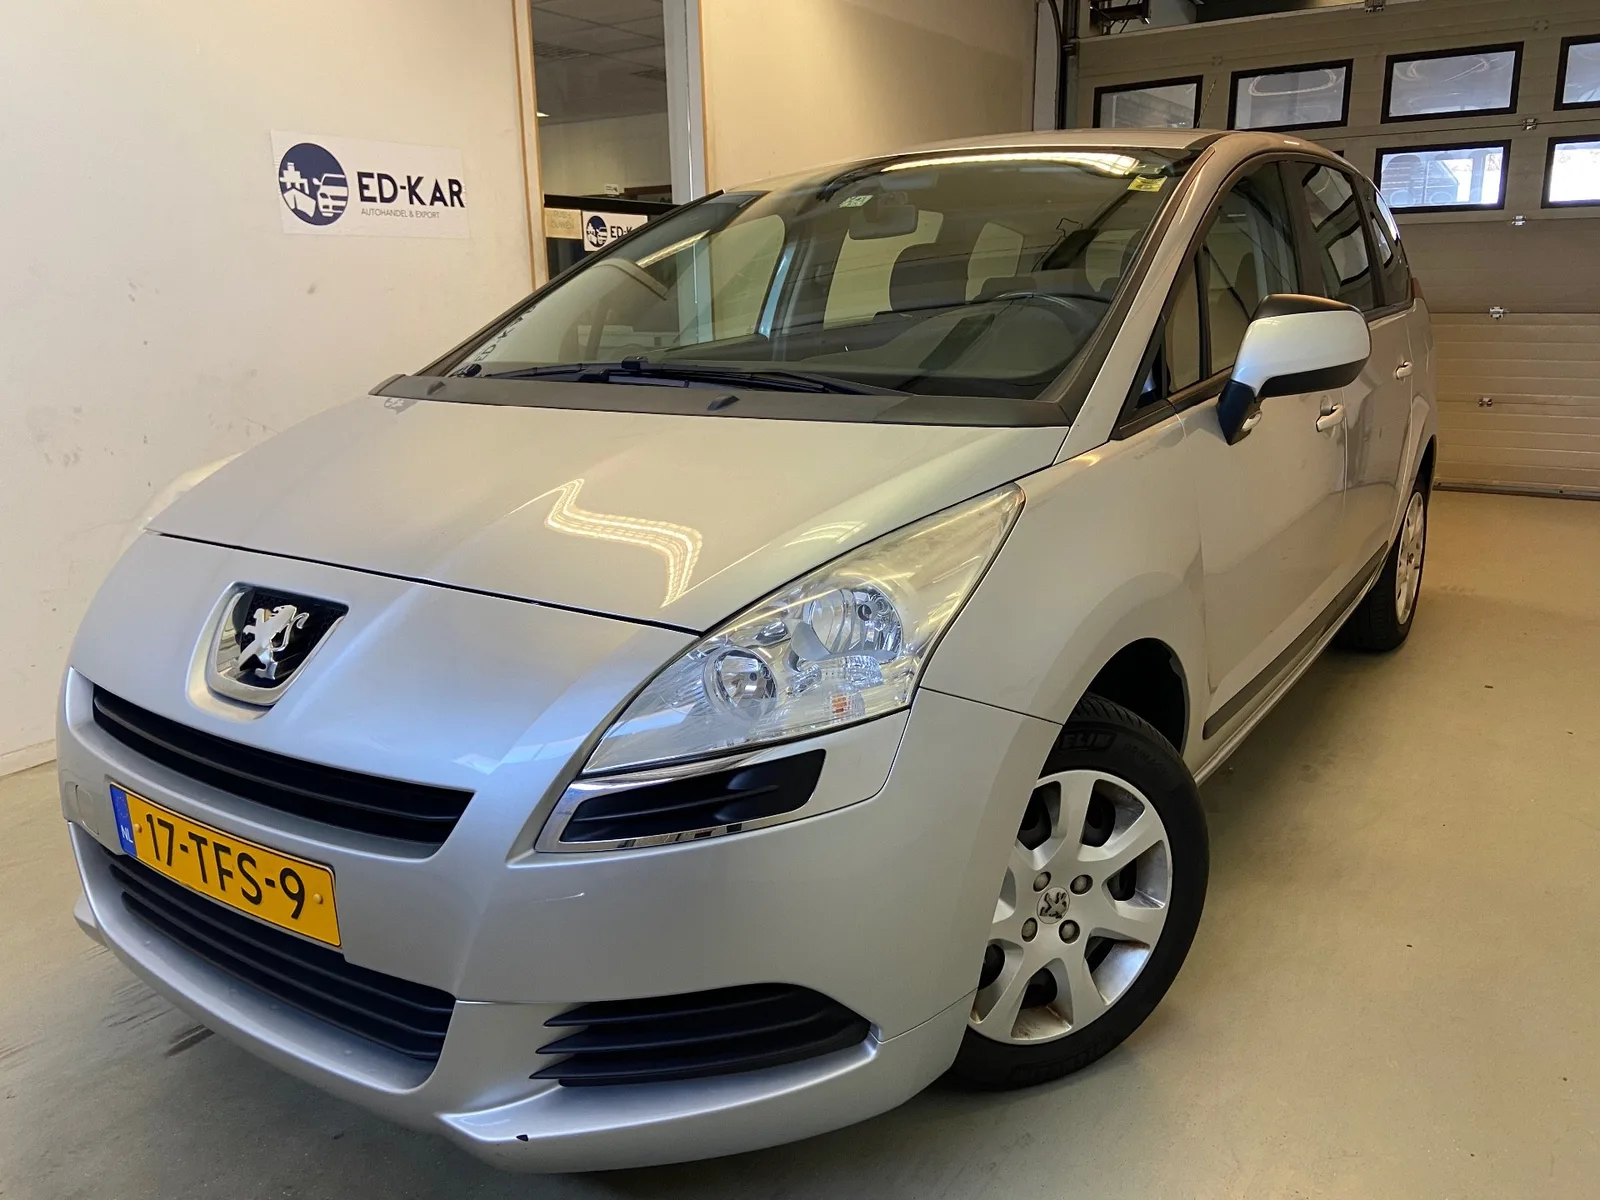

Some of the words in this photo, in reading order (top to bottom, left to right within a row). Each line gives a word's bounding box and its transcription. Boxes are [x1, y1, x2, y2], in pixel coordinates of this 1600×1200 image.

[356, 170, 465, 208] ED-KAR
[361, 208, 408, 218] AUTOHANDEL
[409, 210, 414, 218] &
[415, 210, 440, 219] EXPORT
[121, 825, 134, 844] NL
[146, 813, 305, 920] 17-TFS-9
